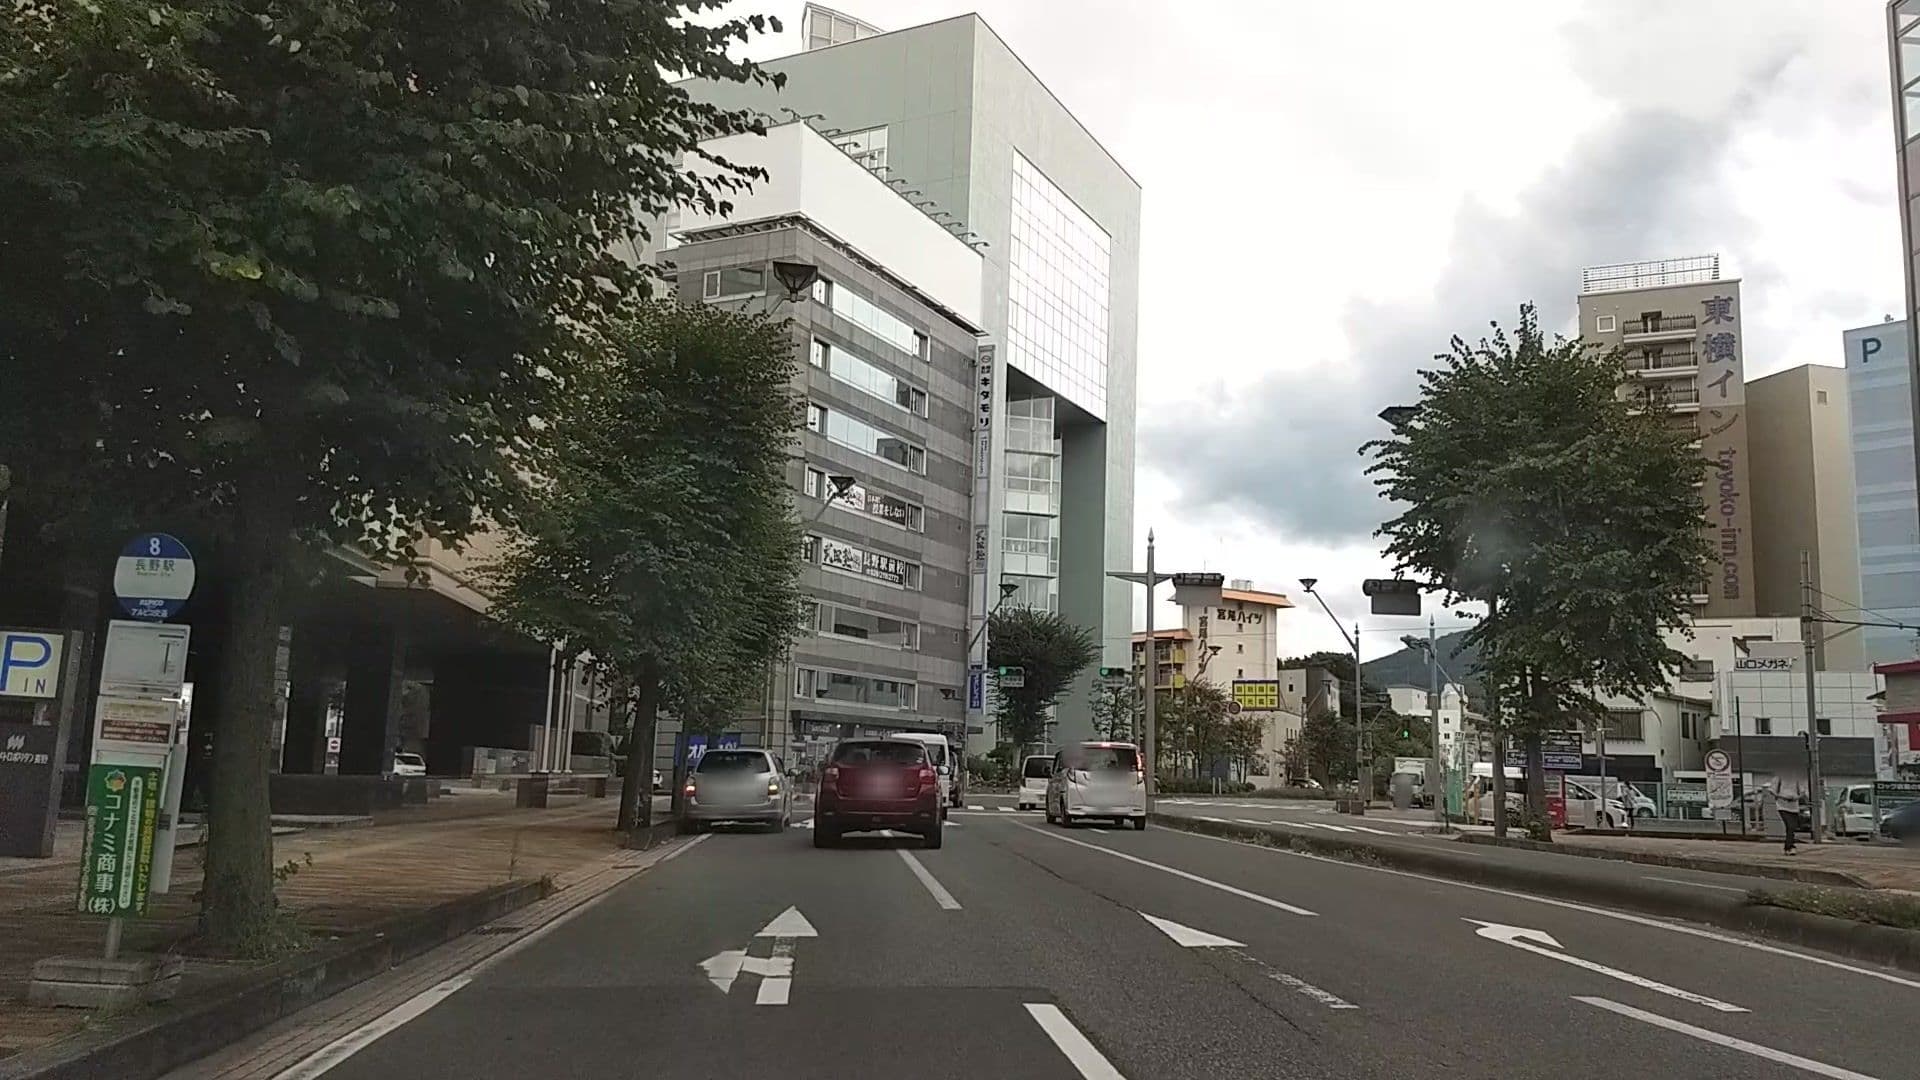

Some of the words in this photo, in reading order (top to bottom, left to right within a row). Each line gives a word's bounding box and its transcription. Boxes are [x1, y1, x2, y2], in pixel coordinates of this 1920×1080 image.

[1862, 337, 1882, 363] P
[1701, 296, 1738, 435] 東横イン
[1716, 448, 1740, 600] toyoko-inn.com
[149, 537, 161, 556] 8
[135, 559, 175, 572] 長野駅
[0, 634, 52, 692] P
[1736, 659, 1789, 670] 山口メガネ
[23, 678, 47, 694] IN
[87, 793, 122, 915] コナミ商事(株)
